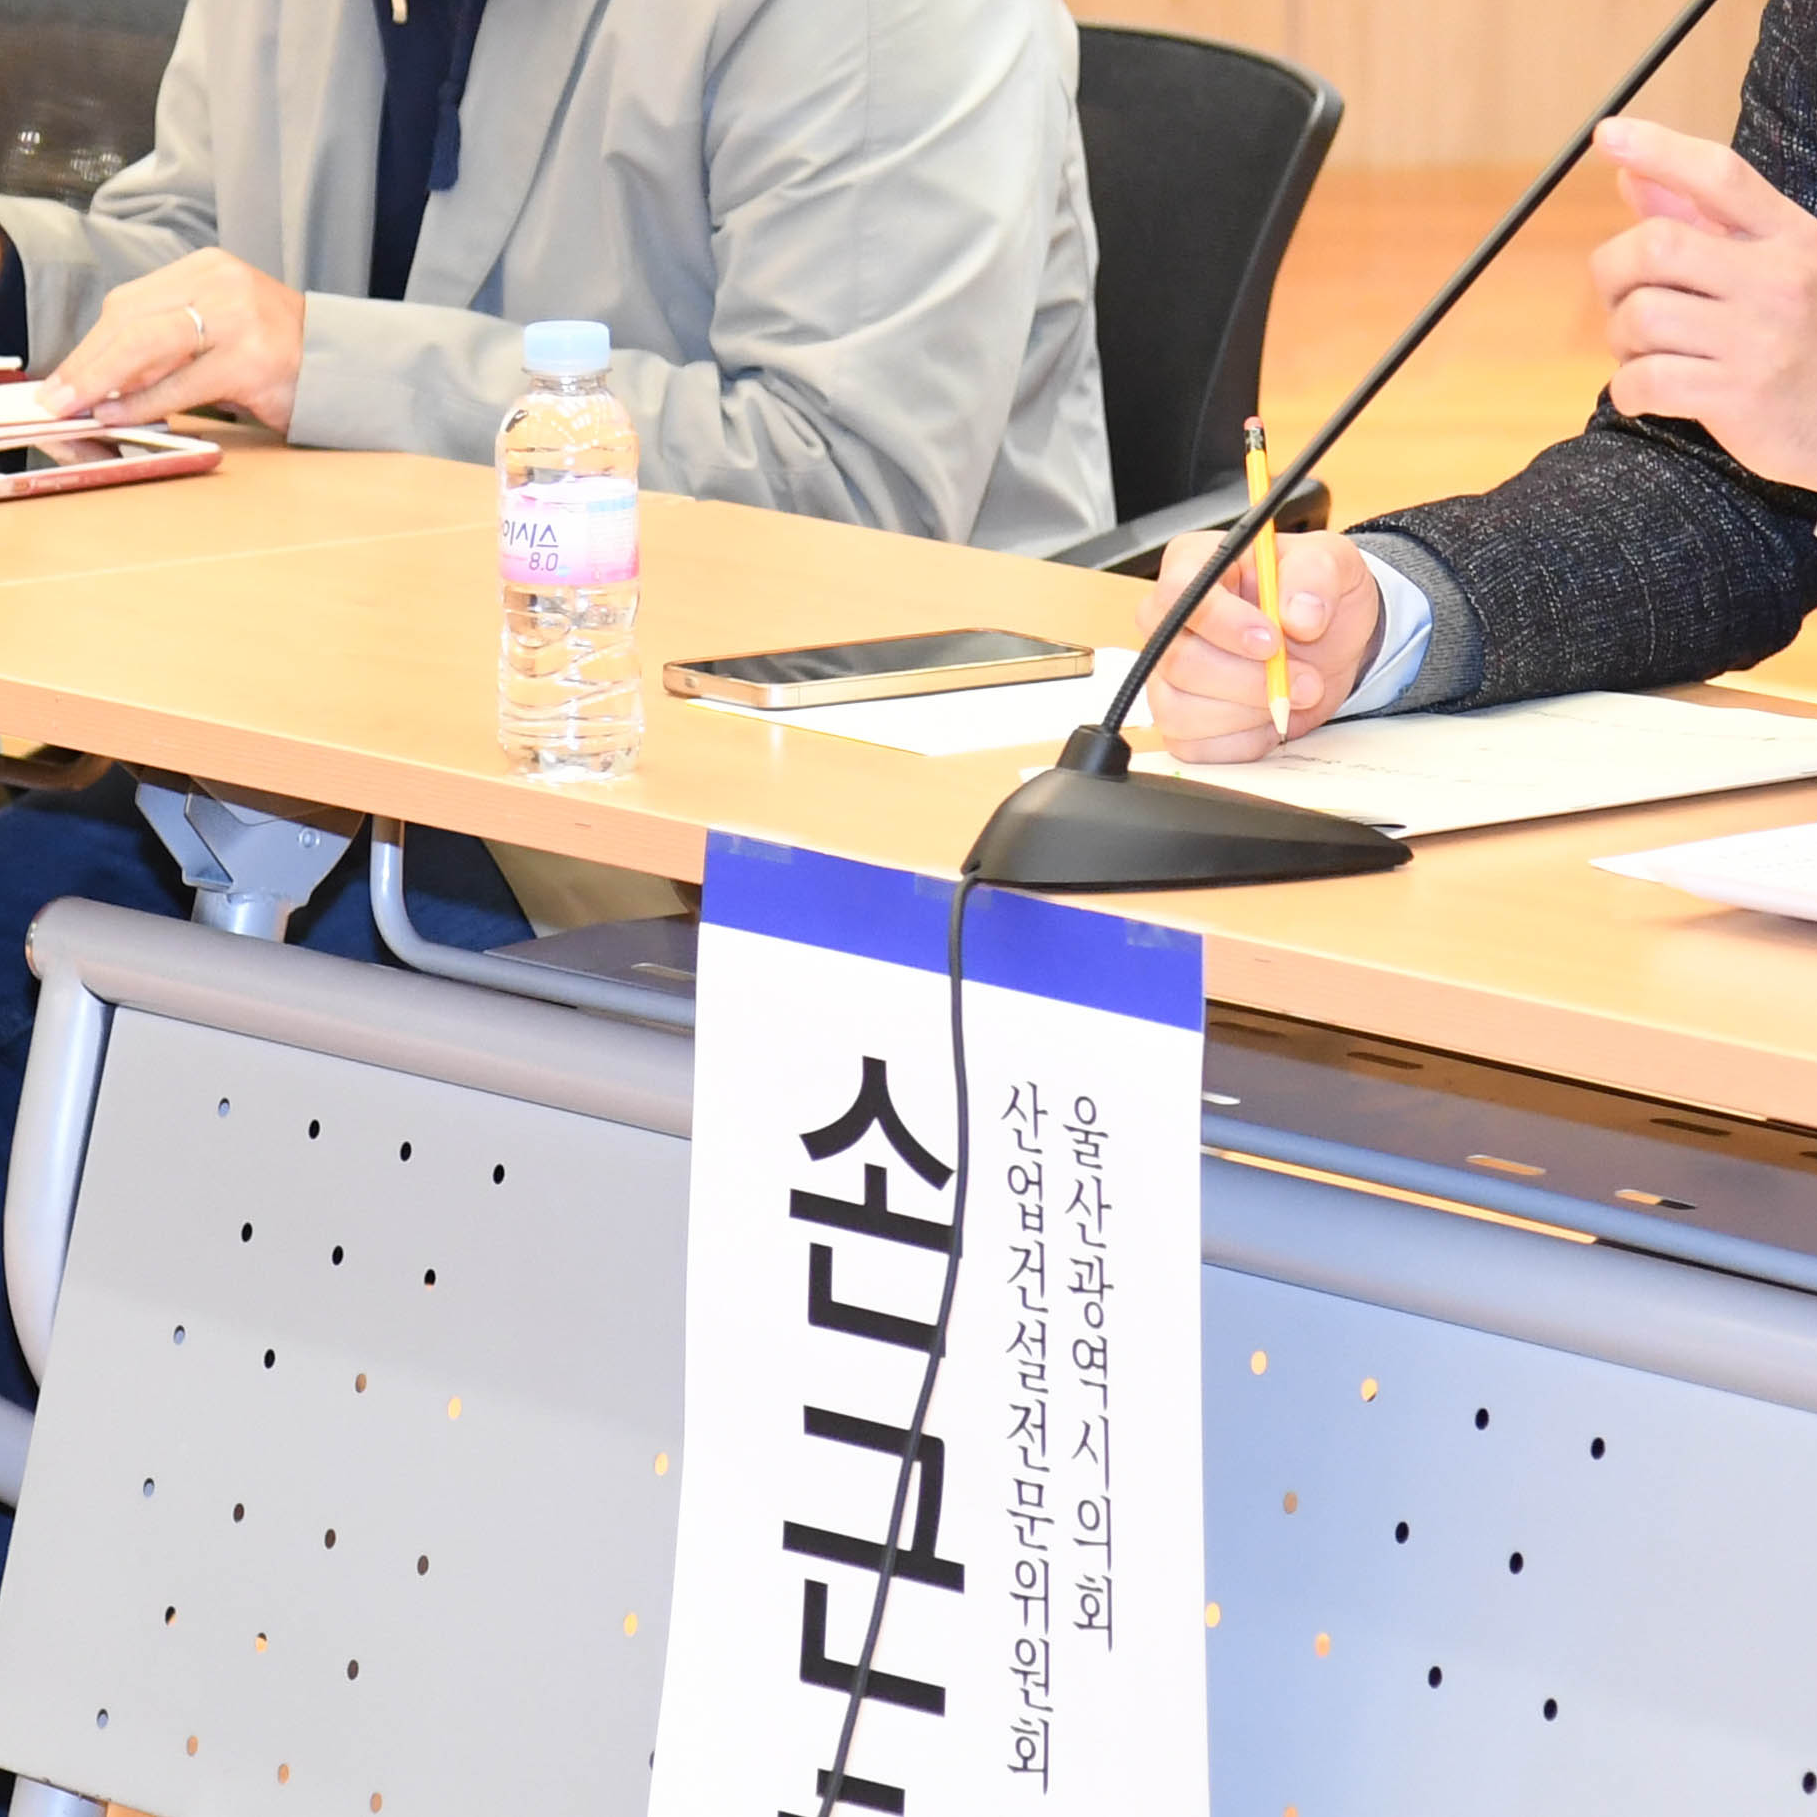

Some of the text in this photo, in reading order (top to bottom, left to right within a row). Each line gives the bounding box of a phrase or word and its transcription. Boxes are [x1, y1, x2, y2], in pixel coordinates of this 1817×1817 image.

[529, 552, 559, 572] 8.0
[778, 1055, 965, 1817] 손근
[1001, 1080, 1055, 1795] 산업건설전문위원회
[1062, 1094, 1115, 1651] 울산광역시의회
